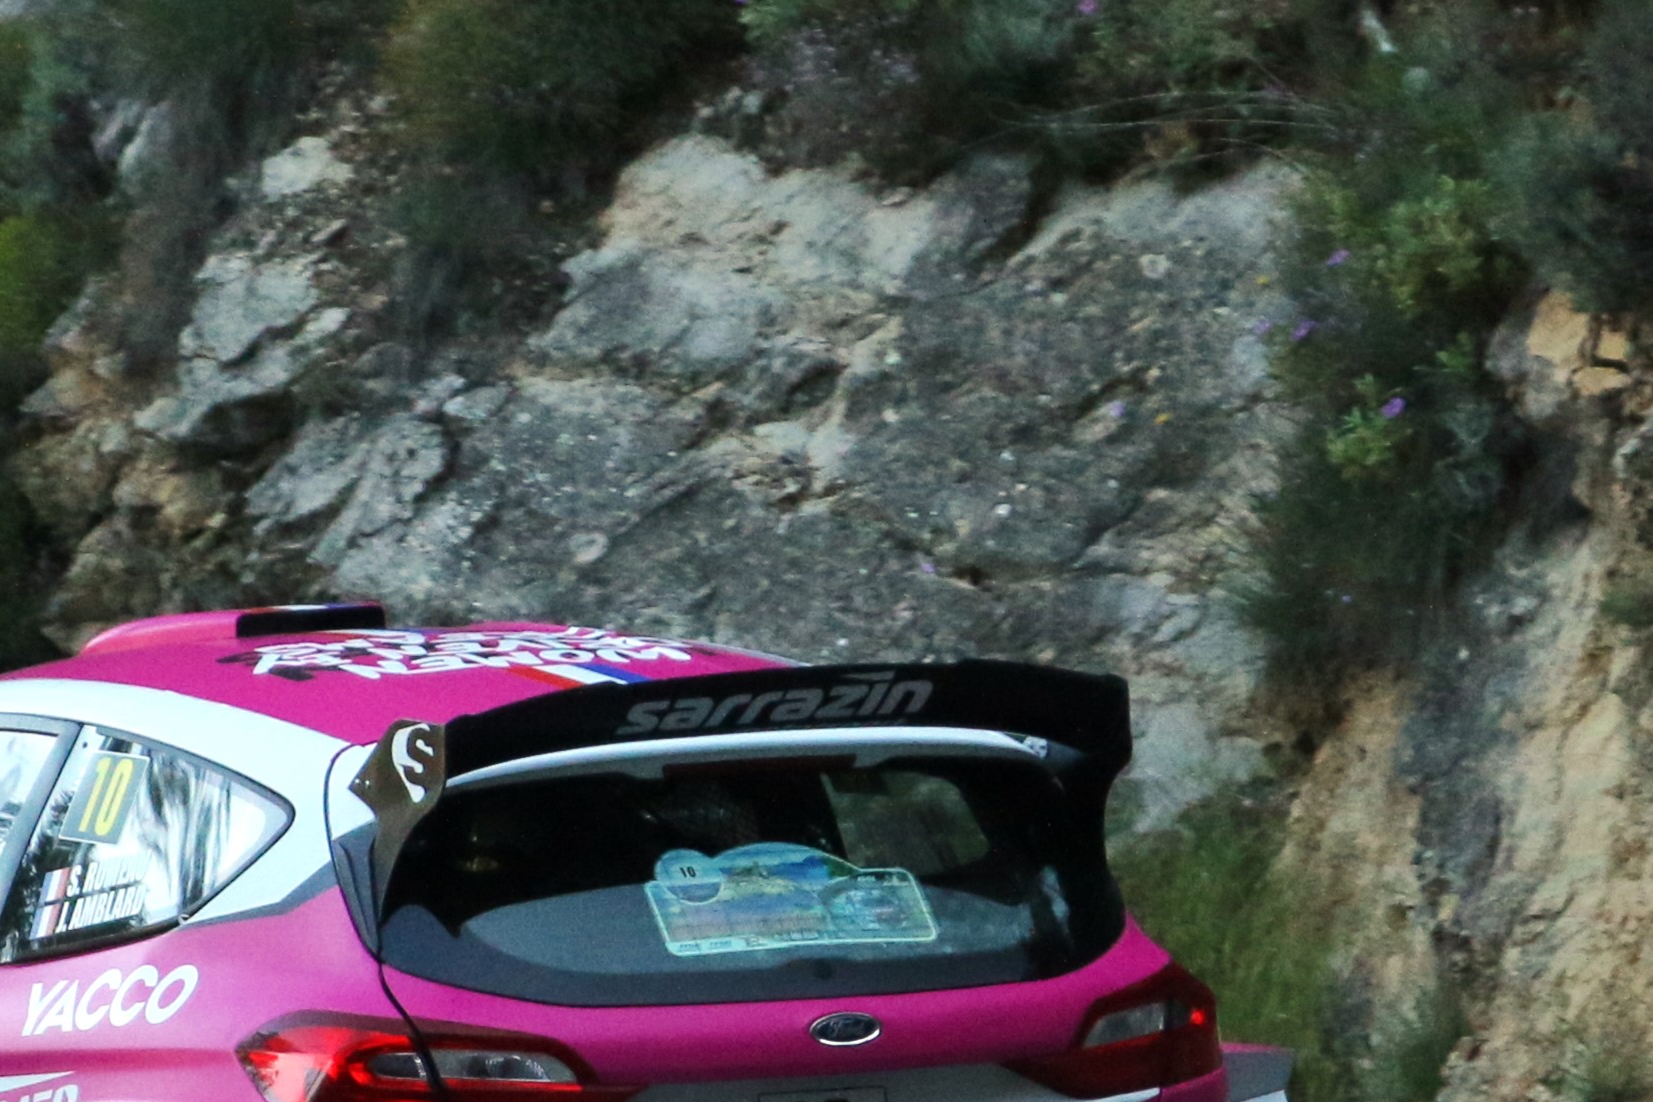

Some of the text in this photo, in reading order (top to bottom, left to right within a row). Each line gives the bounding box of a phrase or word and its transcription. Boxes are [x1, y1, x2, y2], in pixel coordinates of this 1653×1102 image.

[614, 670, 934, 735] sarrazin
[77, 756, 134, 836] 10
[679, 865, 697, 878] 10
[69, 884, 147, 930] AMBLARD
[21, 964, 199, 1036] YACCO
